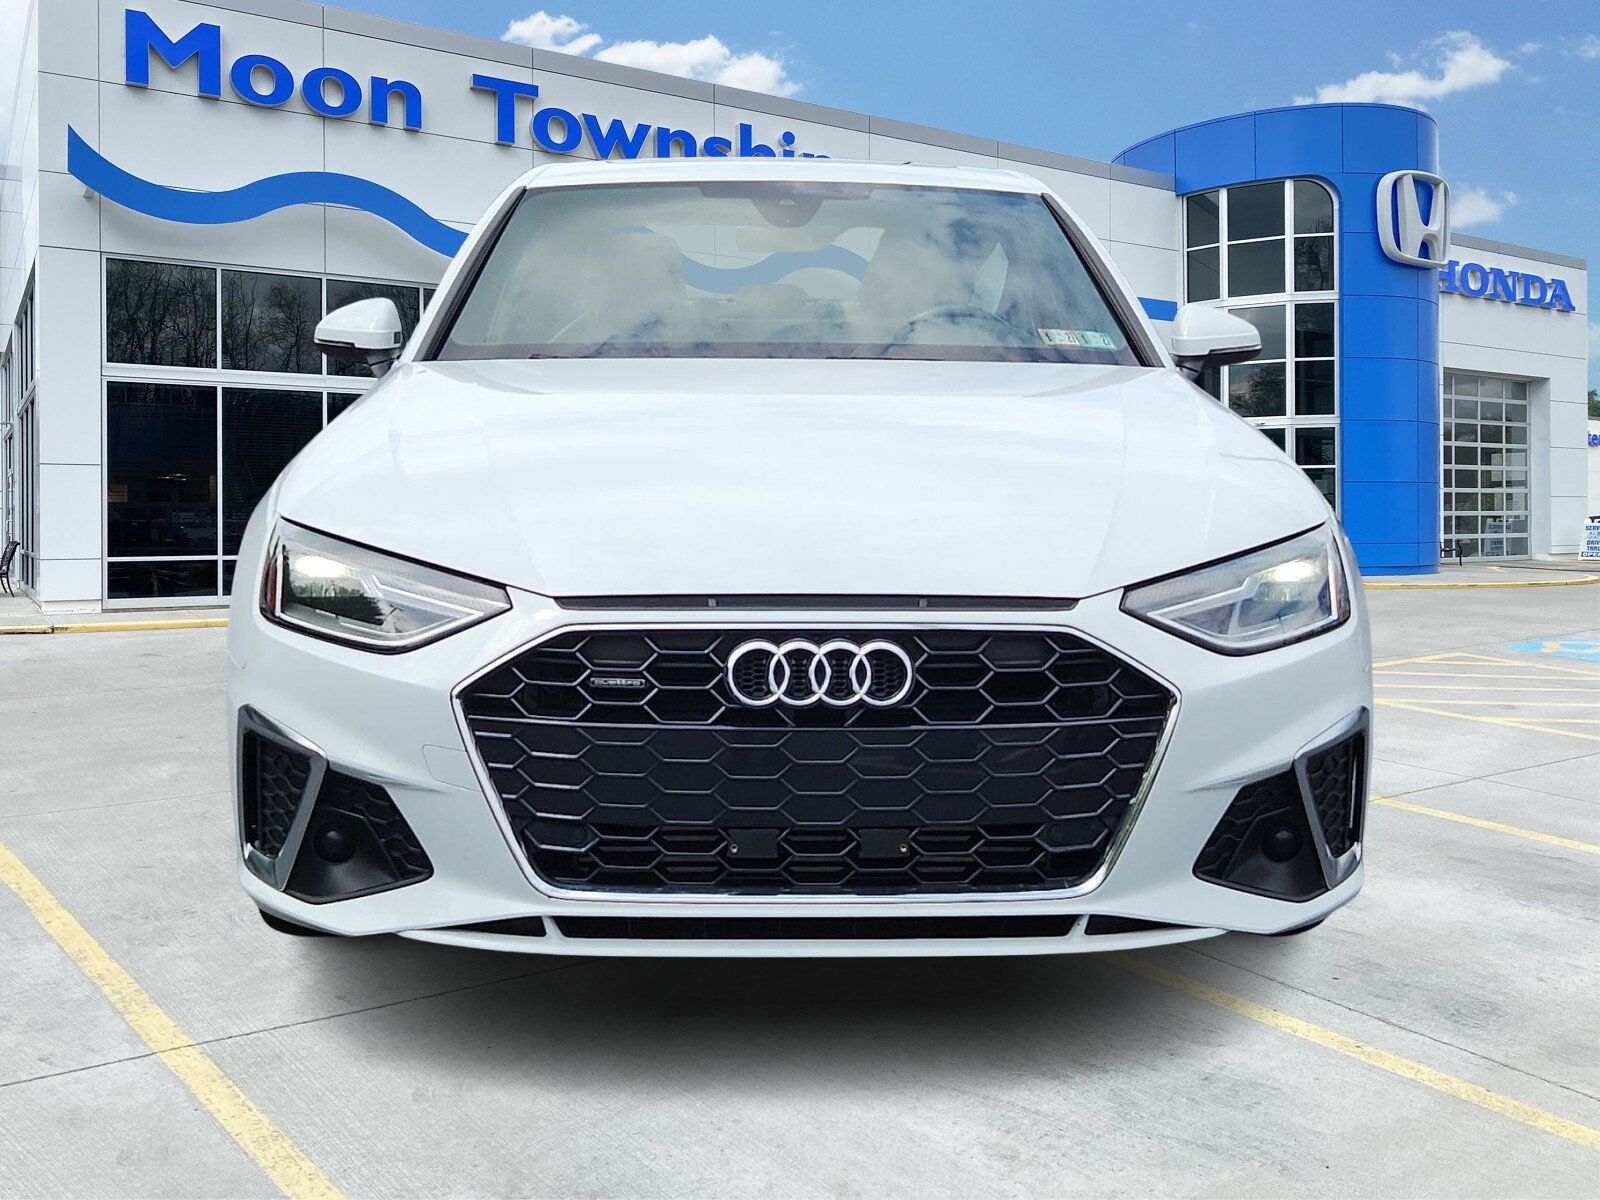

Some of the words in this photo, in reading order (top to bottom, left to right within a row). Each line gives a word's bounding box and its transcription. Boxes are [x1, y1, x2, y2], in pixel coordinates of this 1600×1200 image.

[124, 8, 422, 131] Moon
[469, 73, 831, 160] Townsh
[1438, 259, 1577, 312] HONDA
